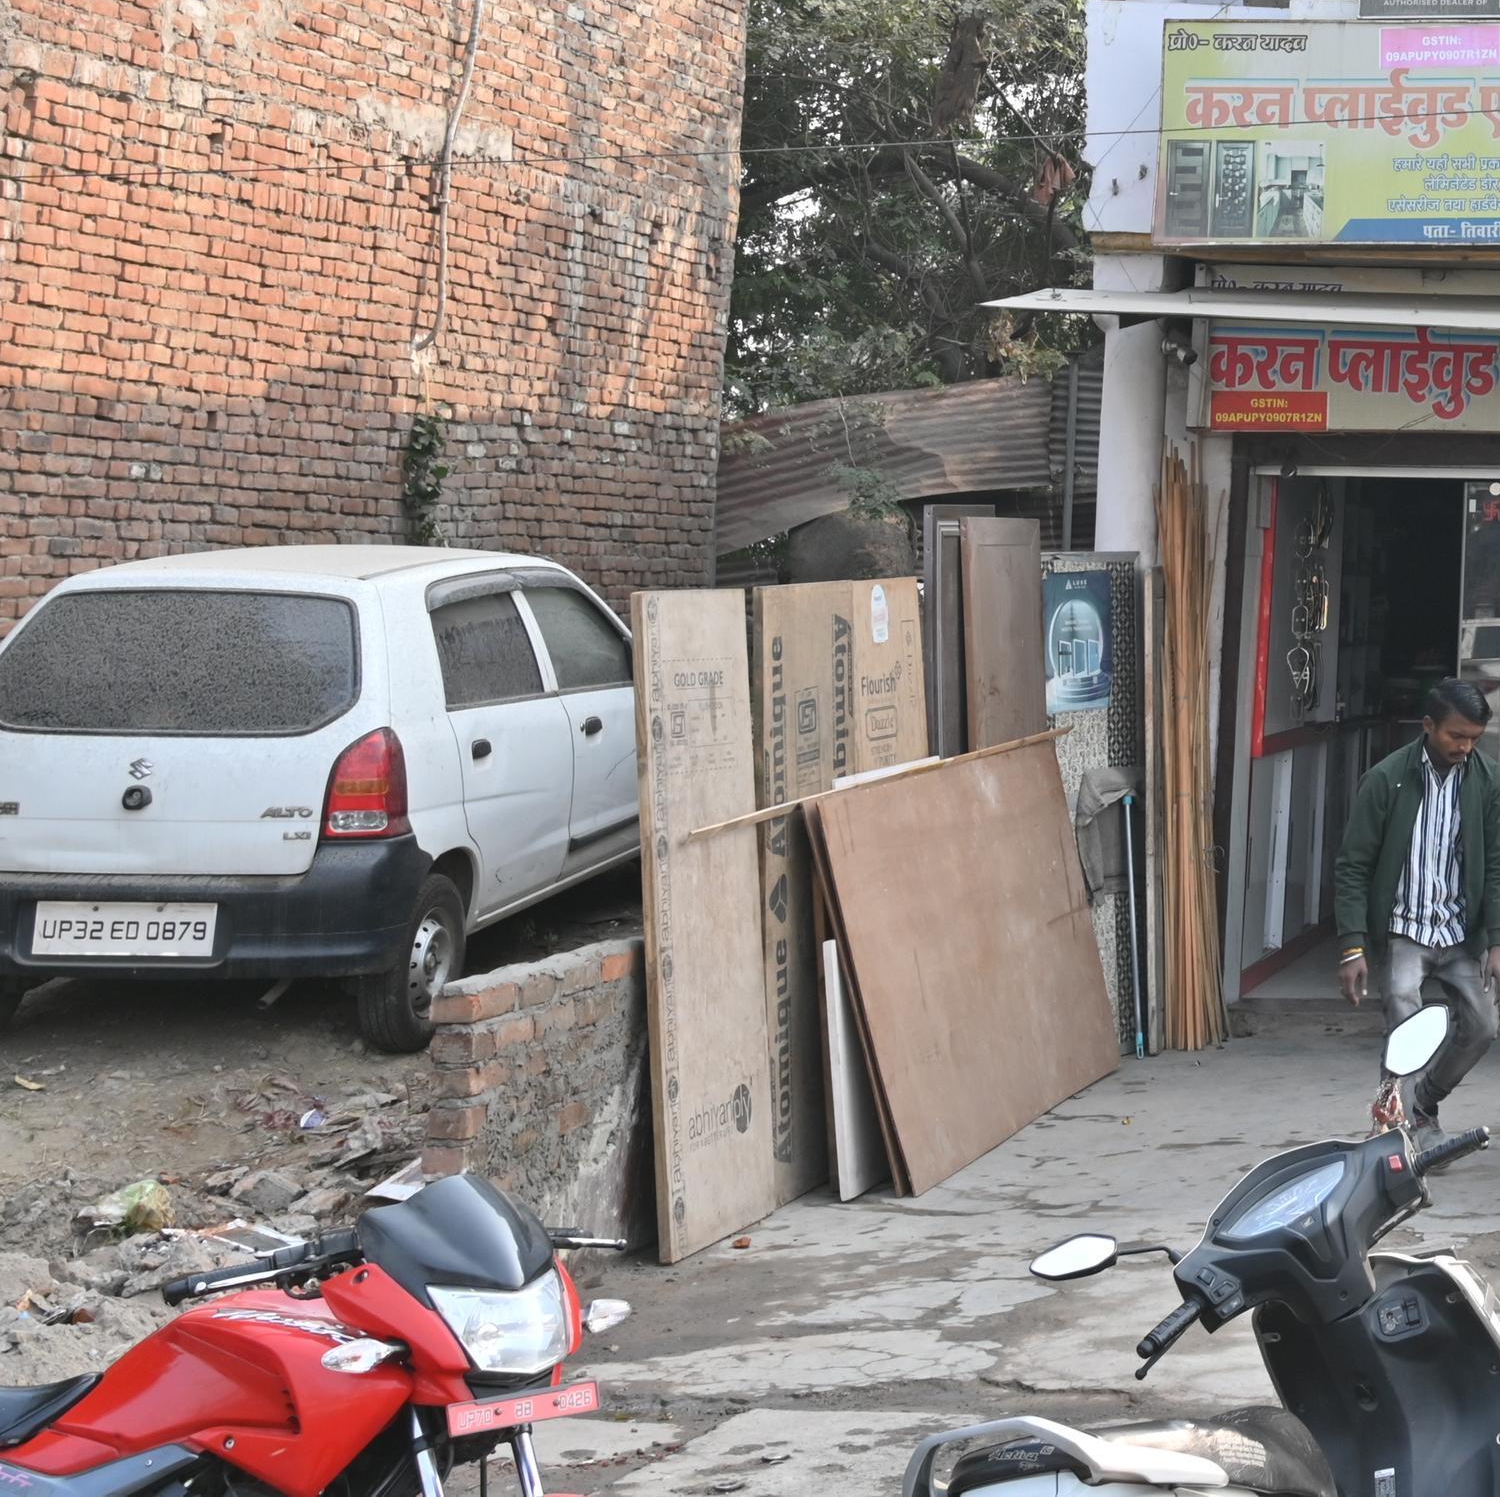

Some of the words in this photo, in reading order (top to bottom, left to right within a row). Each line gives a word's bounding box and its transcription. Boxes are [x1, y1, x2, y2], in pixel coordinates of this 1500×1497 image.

[1185, 83, 1295, 129] करन
[1303, 68, 1470, 149] प्लाईवुड
[1209, 335, 1320, 391] करन
[1327, 324, 1500, 420] प्लाईवुड
[1250, 398, 1288, 410] GSTIN:
[674, 672, 696, 688] GOLD
[698, 670, 724, 687] GRADE
[861, 671, 897, 696] Flourish
[260, 807, 314, 819] ALTO
[42, 919, 104, 940] UP32
[110, 921, 140, 940] ED
[146, 921, 207, 941] 0879
